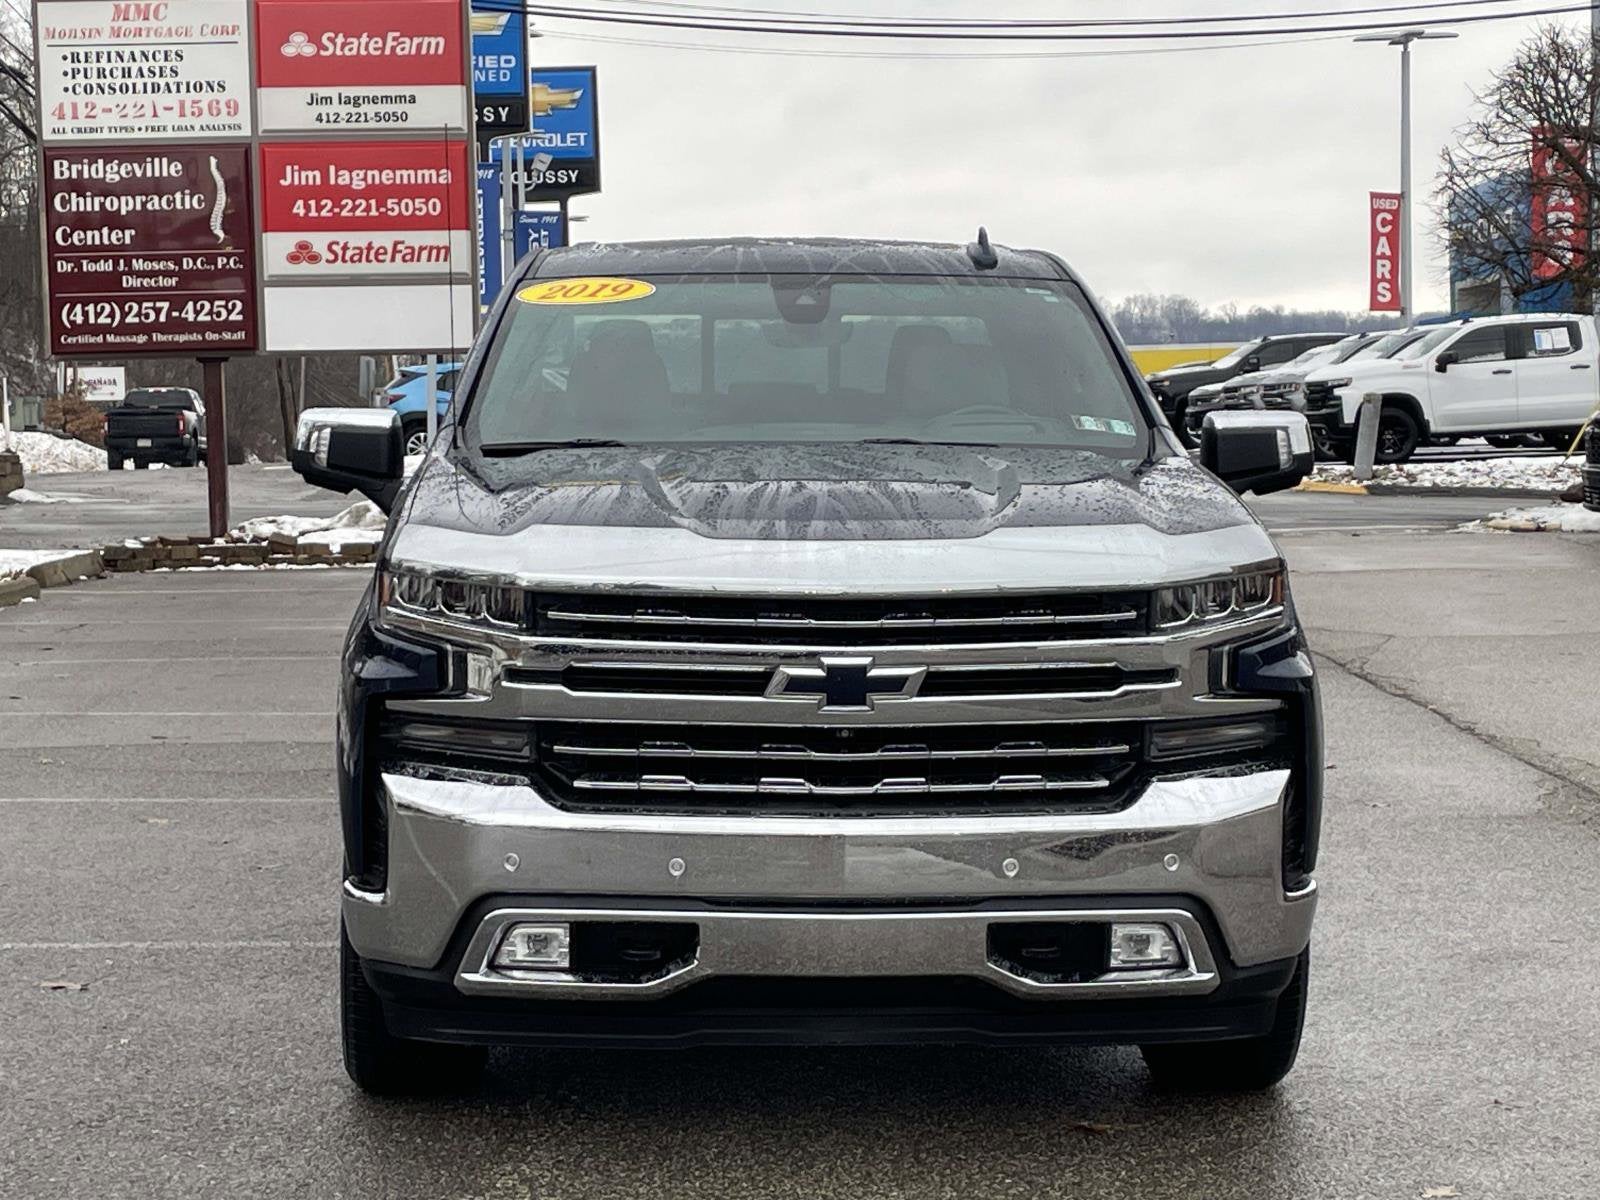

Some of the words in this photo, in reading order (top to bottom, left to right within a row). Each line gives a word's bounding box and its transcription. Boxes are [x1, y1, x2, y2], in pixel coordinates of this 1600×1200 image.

[111, 2, 169, 22] MMC
[108, 25, 194, 39] MORTGAGE
[70, 49, 185, 64] REFINANCES
[70, 65, 180, 80] PURCHASES
[71, 80, 227, 95] CONSOLIDATIONS
[306, 92, 334, 107] Jim
[338, 92, 417, 109] Iagnemma
[51, 98, 240, 121] 412-221-1569
[315, 111, 409, 124] 412-221-5050
[51, 127, 68, 135] ALL
[71, 126, 105, 135] CREDIT
[107, 125, 135, 134] TYPES
[145, 125, 169, 133] FREE
[172, 124, 196, 132] LOAN
[199, 123, 243, 132] ANALYSIS
[489, 132, 588, 148] EVROLET
[53, 157, 183, 183] Bridgeville
[279, 164, 321, 186] Jim
[329, 164, 452, 190] Iagnemma
[499, 169, 579, 185] OLUSSY
[53, 189, 206, 216] Chiropractic
[291, 197, 442, 217] 412-221-5050
[1372, 198, 1399, 210] USED
[55, 225, 136, 247] Center
[56, 261, 78, 273] Dr.
[81, 259, 113, 272] Todd
[117, 258, 129, 272] J.
[131, 258, 179, 272] Moses,
[217, 255, 244, 269] P.C.
[1375, 212, 1393, 303] CARS
[122, 275, 179, 288] Director
[537, 283, 635, 300] 2019
[60, 333, 104, 344] Certified
[106, 332, 149, 344] Massage
[151, 331, 203, 343] Therapists
[205, 330, 246, 340] On-Staff
